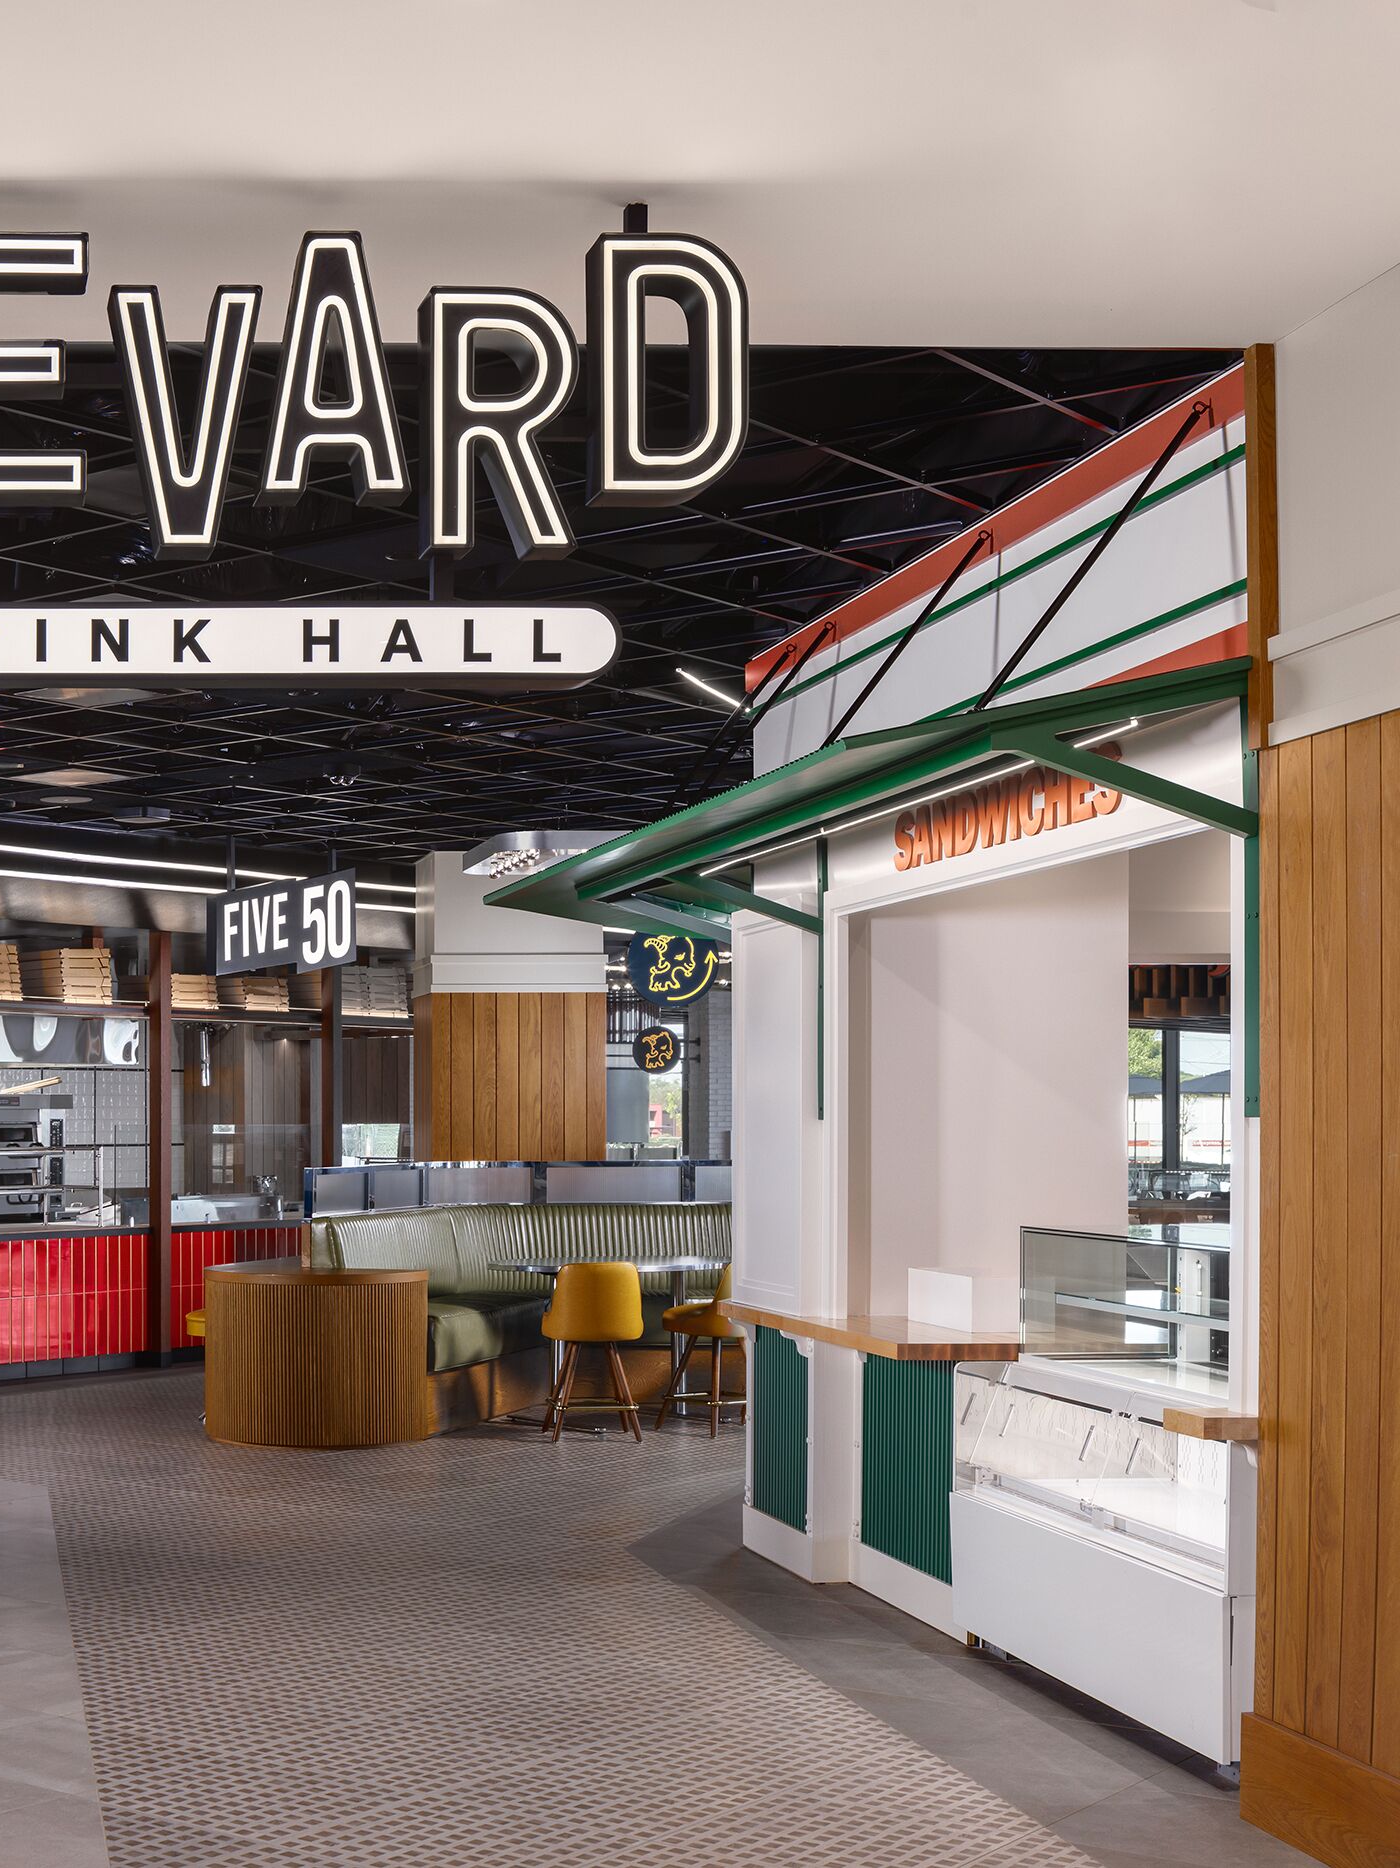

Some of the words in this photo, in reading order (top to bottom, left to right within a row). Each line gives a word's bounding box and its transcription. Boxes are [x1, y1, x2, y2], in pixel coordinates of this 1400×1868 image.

[302, 618, 563, 663] HALL
[224, 892, 288, 961] FIVE
[302, 880, 351, 964] 50
